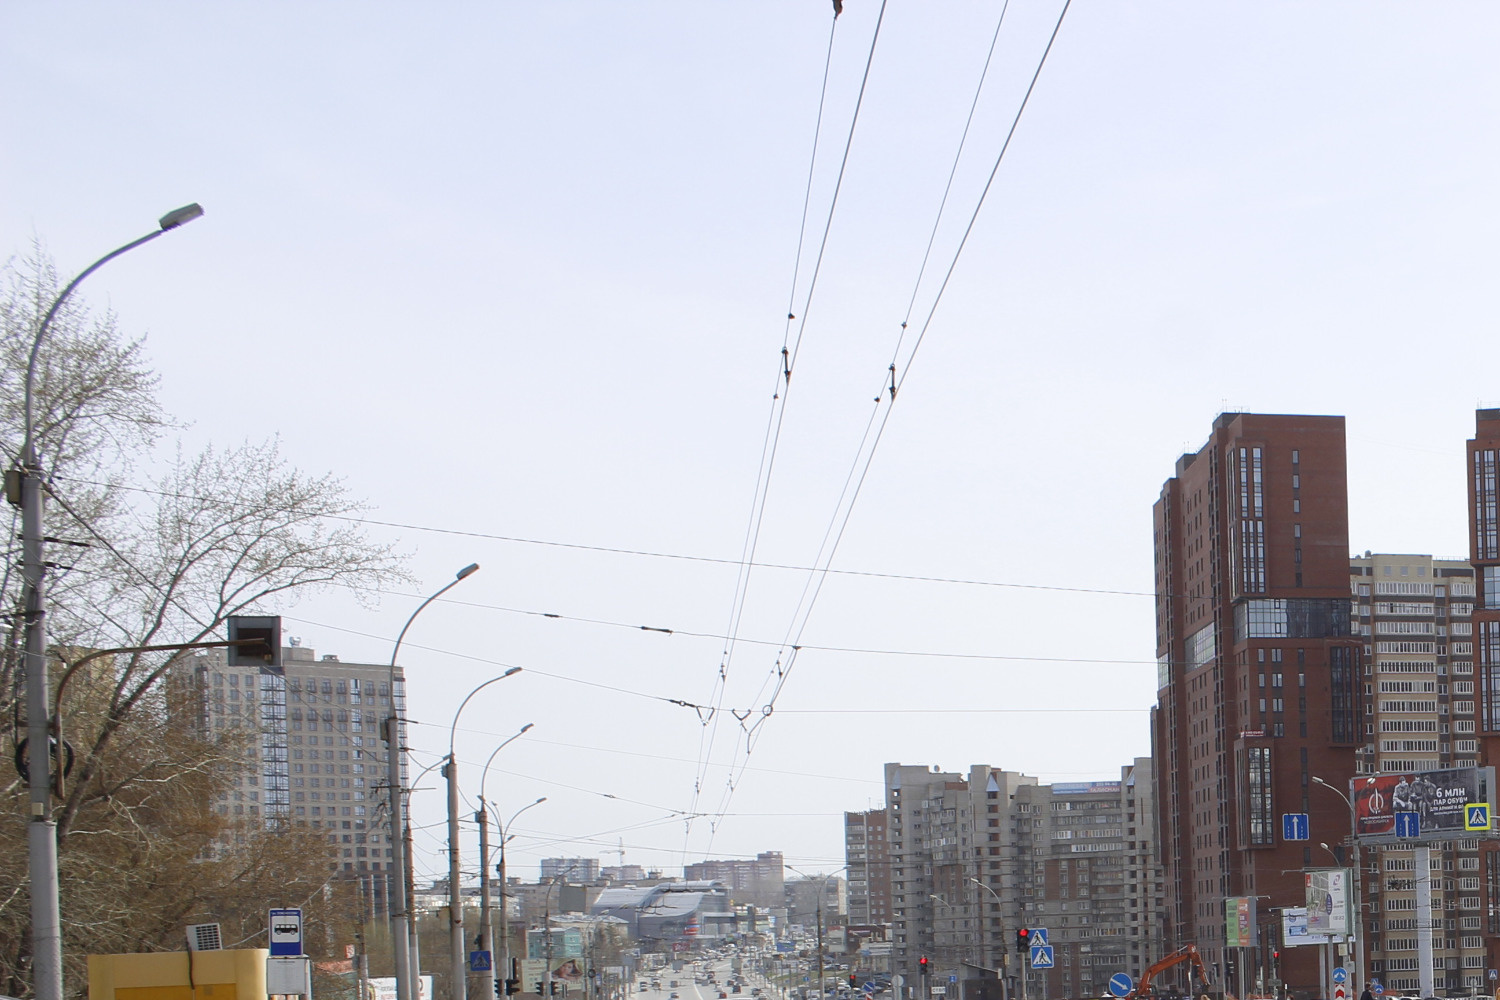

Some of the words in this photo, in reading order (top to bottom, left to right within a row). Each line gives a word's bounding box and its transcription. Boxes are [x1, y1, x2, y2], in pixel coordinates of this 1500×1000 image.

[1436, 787, 1443, 798] 6
[1445, 787, 1465, 798] МЛН
[1447, 796, 1468, 804] ОБУВИ
